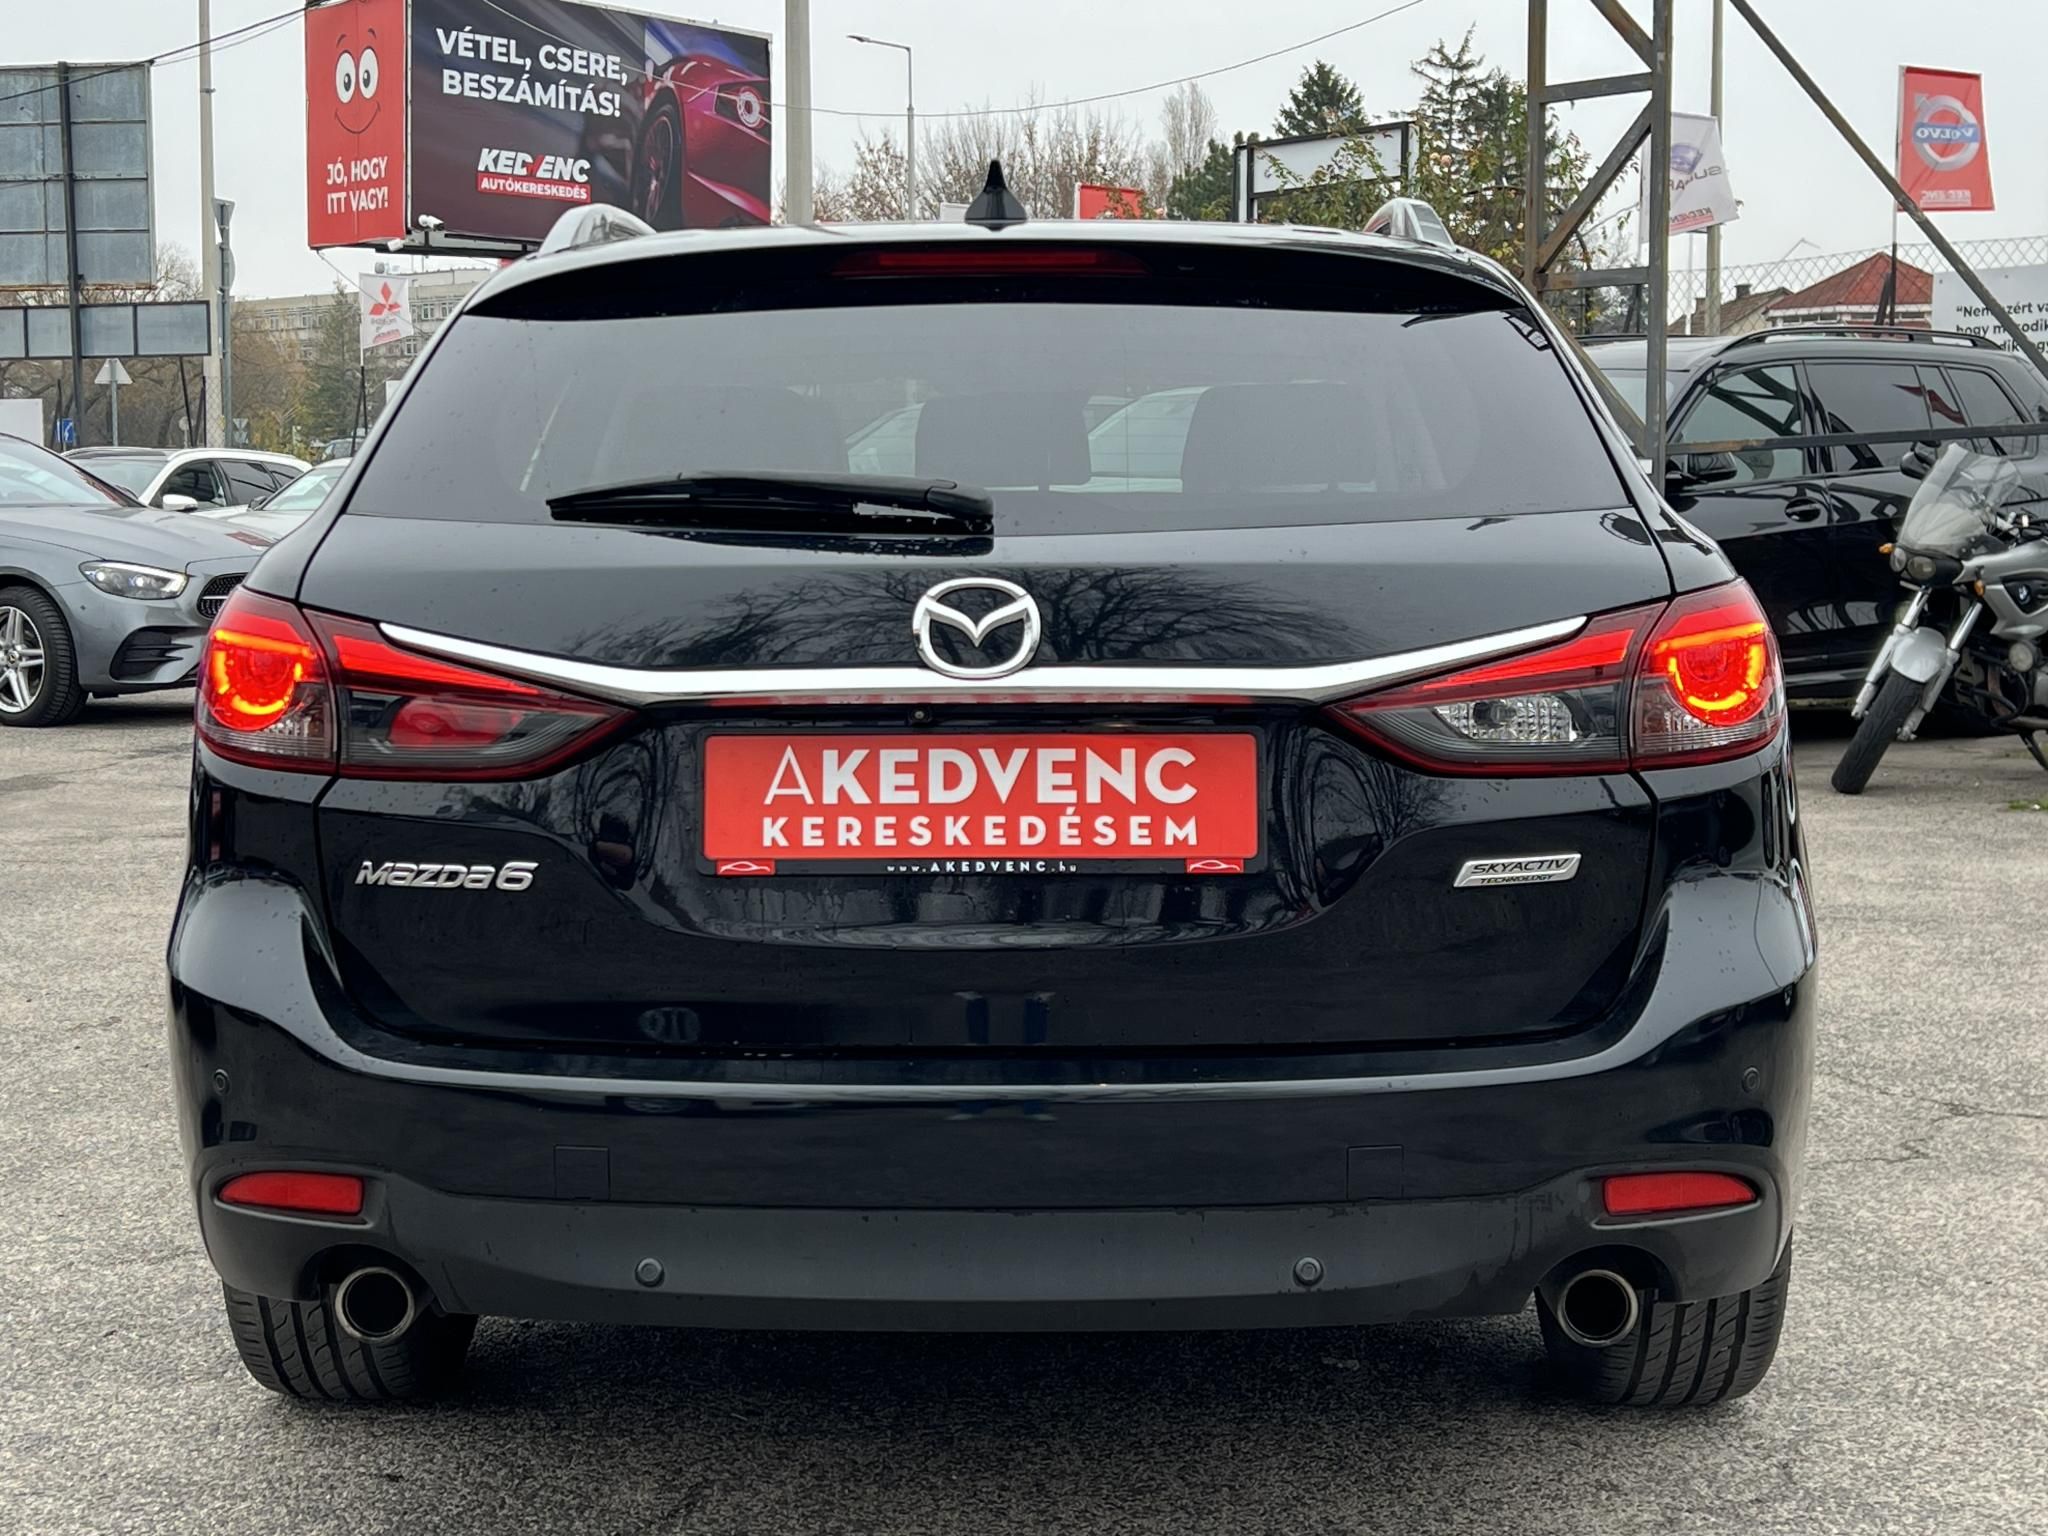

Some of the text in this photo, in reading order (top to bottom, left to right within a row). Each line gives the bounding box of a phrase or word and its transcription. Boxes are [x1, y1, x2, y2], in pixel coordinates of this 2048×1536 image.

[436, 26, 627, 86] VÉTEL, CSERE,
[442, 68, 620, 118] BESZÁMÍTÁS!
[327, 155, 388, 187] JÓ, HOGY
[478, 148, 591, 183] KEDVENC
[327, 186, 388, 215] ITT VAGY!
[481, 177, 588, 200] AUTÓKERESKEDÉS
[2006, 301, 2033, 315] zért
[763, 808, 1198, 847] KERESKEDÉSEM
[887, 861, 1077, 873] www.AKEDVENC.hu
[1472, 858, 1570, 874] SKYACTIV
[1480, 874, 1556, 884] TECHNOLOGY
